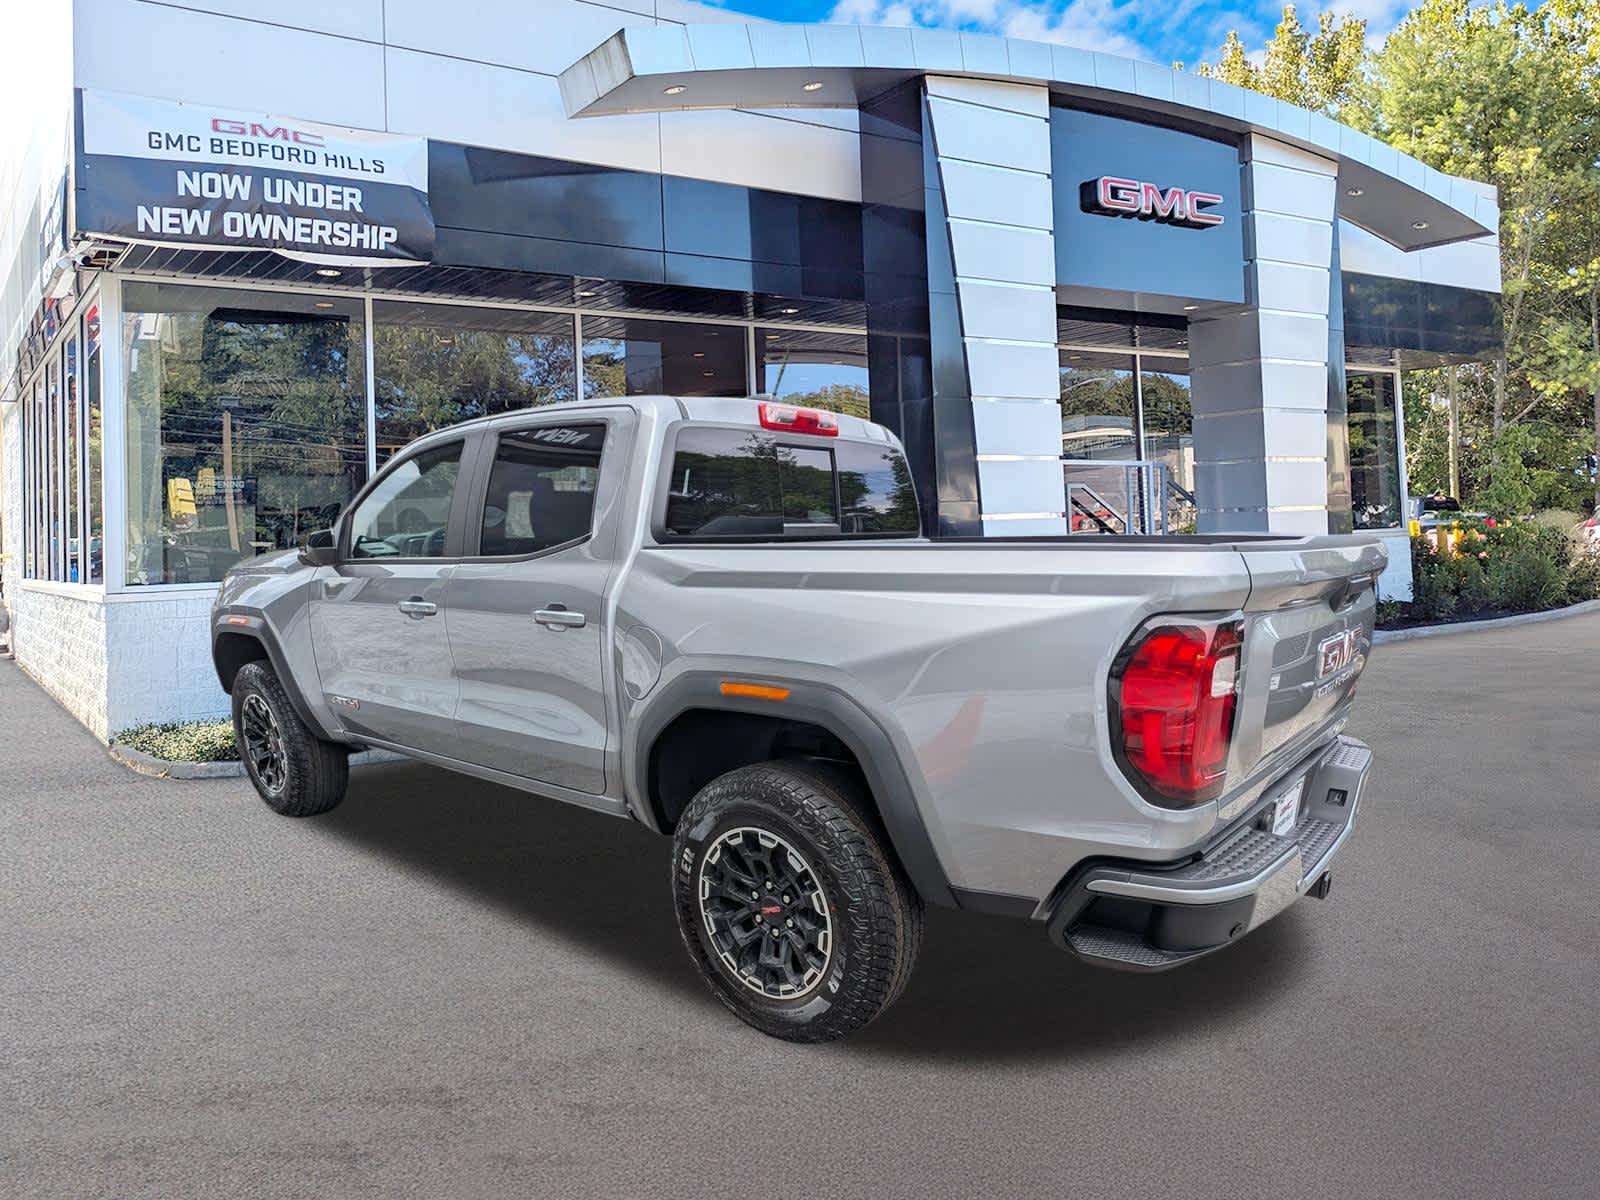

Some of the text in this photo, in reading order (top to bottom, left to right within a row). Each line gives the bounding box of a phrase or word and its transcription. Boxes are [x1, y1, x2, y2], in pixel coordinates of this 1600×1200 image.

[148, 131, 384, 174] GMC BEDFORD HILLS
[211, 118, 325, 147] GMC
[176, 170, 364, 213] NOW UNDER
[1098, 175, 1225, 225] GMC
[136, 205, 398, 250] NEW OWNERSHIP
[1317, 624, 1362, 680] GMC
